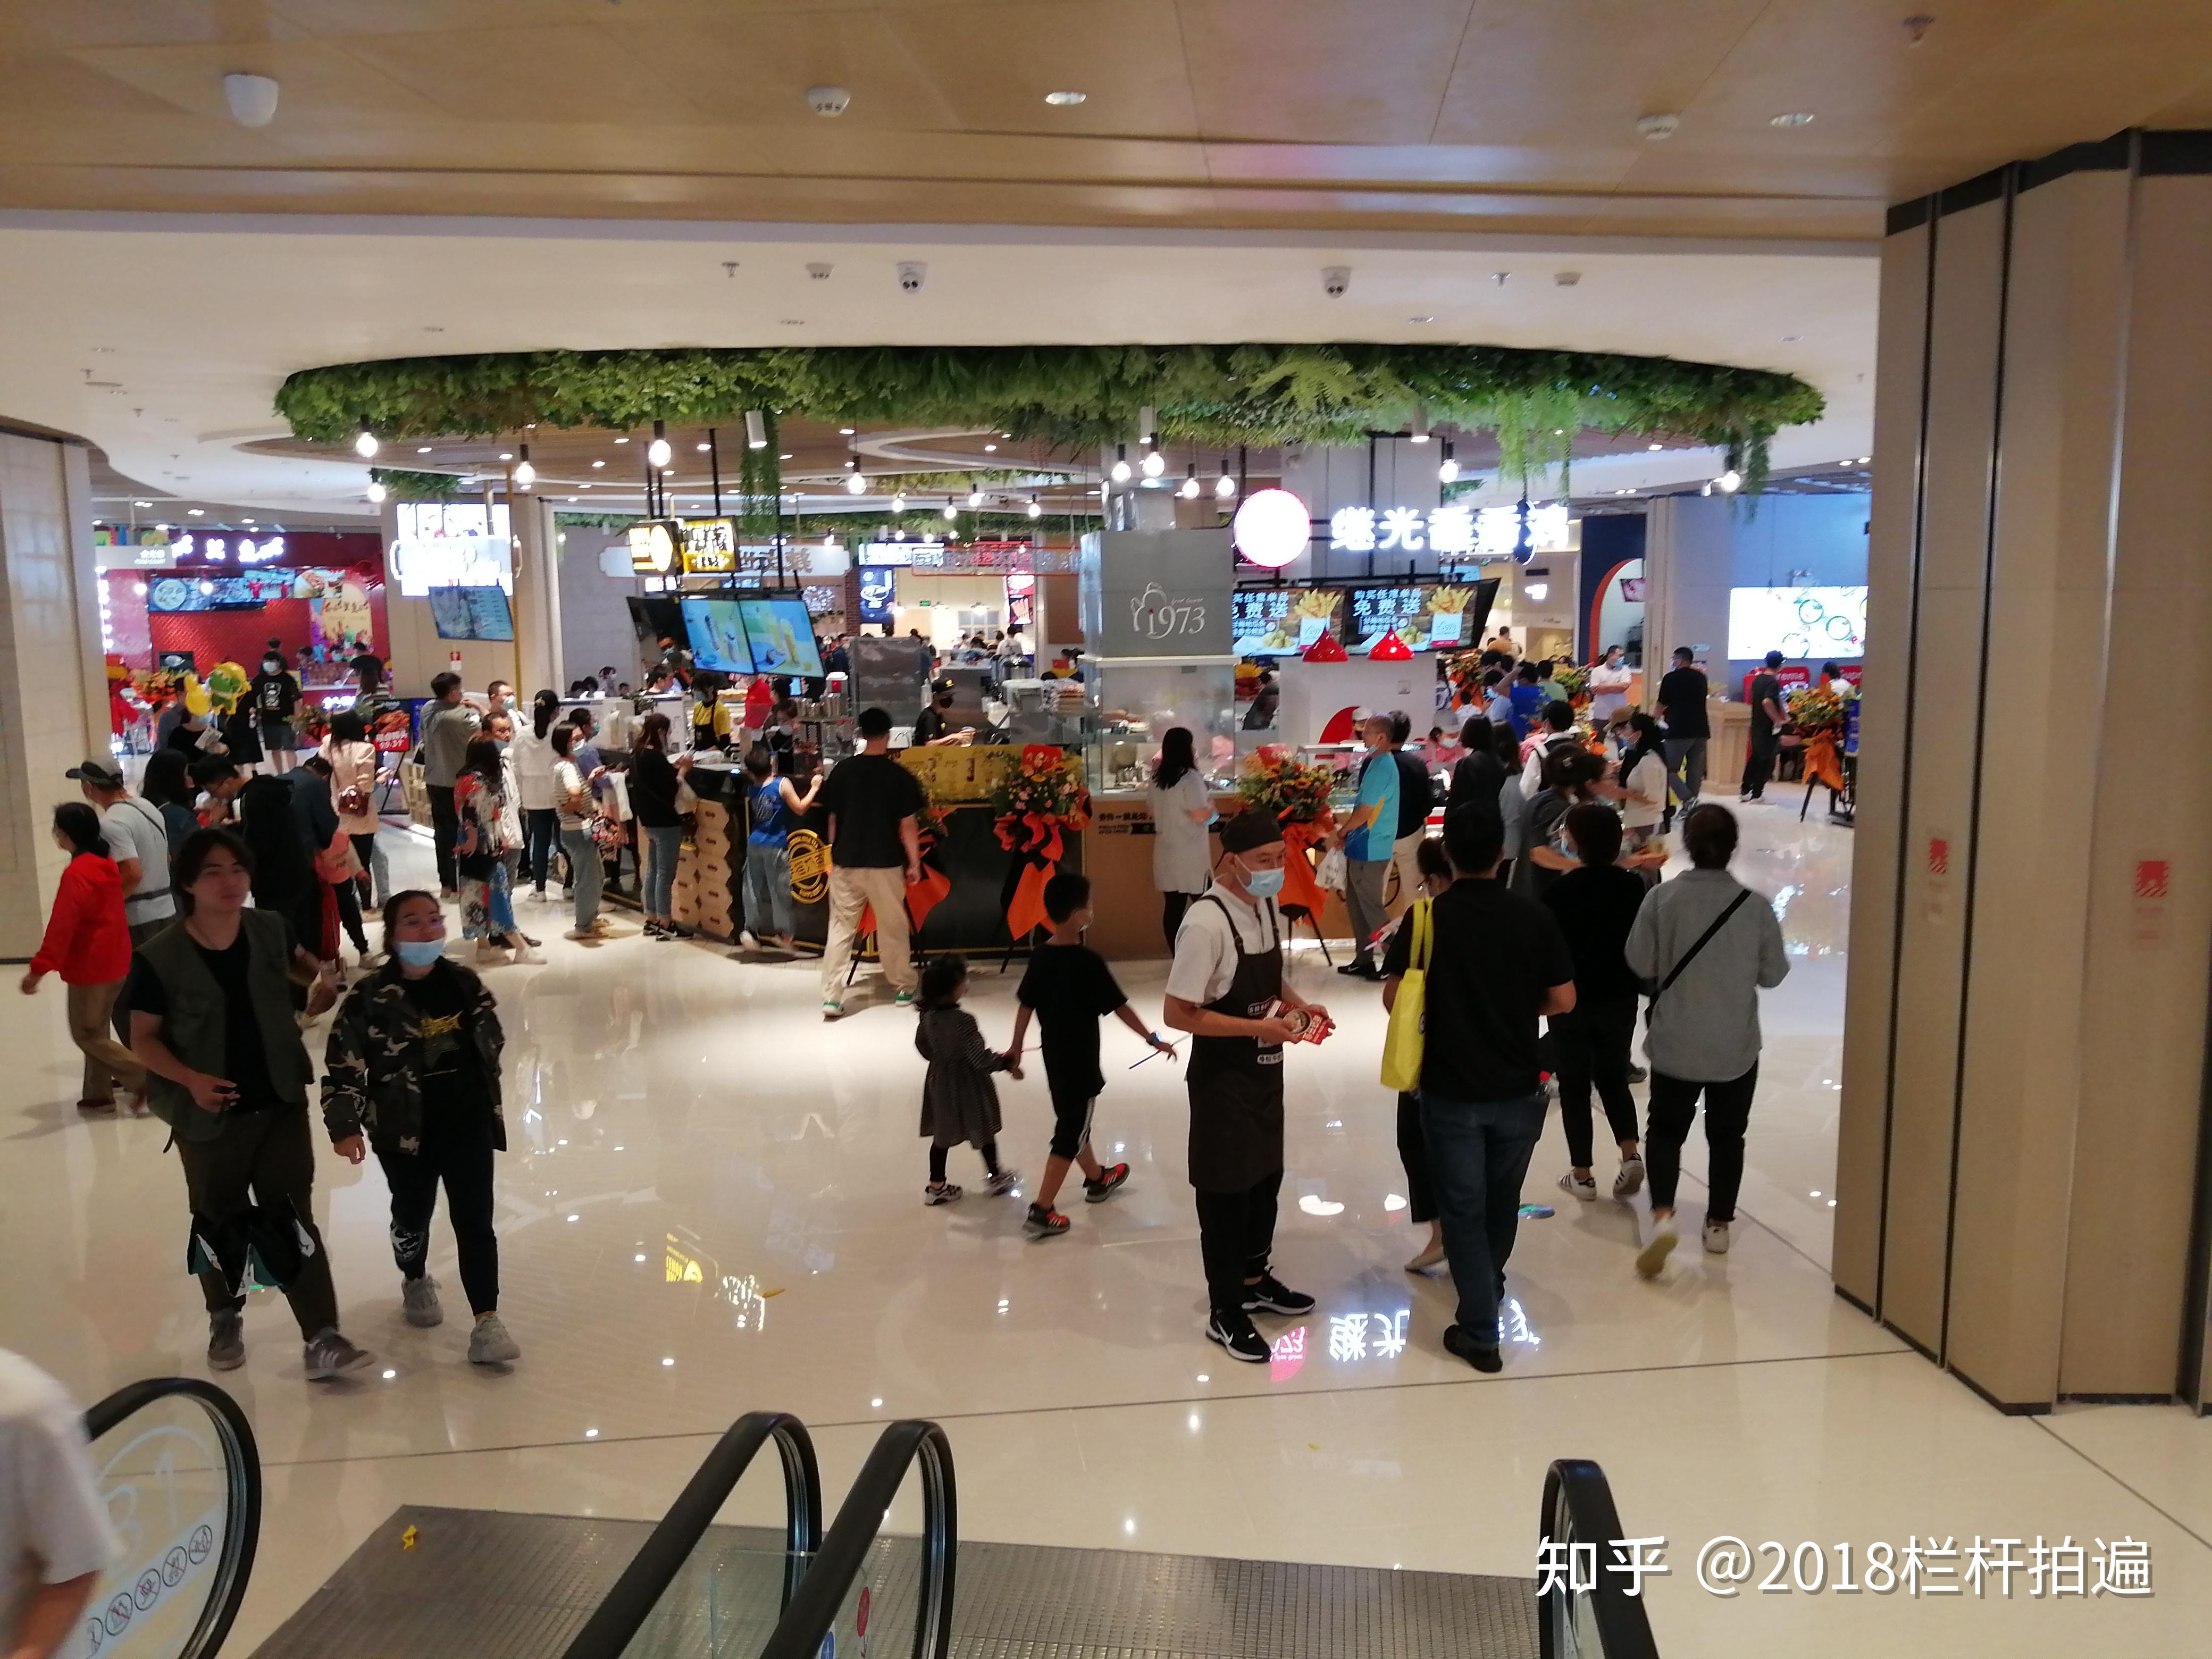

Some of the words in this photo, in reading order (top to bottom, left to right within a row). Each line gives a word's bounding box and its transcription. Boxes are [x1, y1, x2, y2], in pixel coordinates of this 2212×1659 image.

[1353, 598, 1421, 616] 免费送
[1146, 606, 1206, 639] 1973
